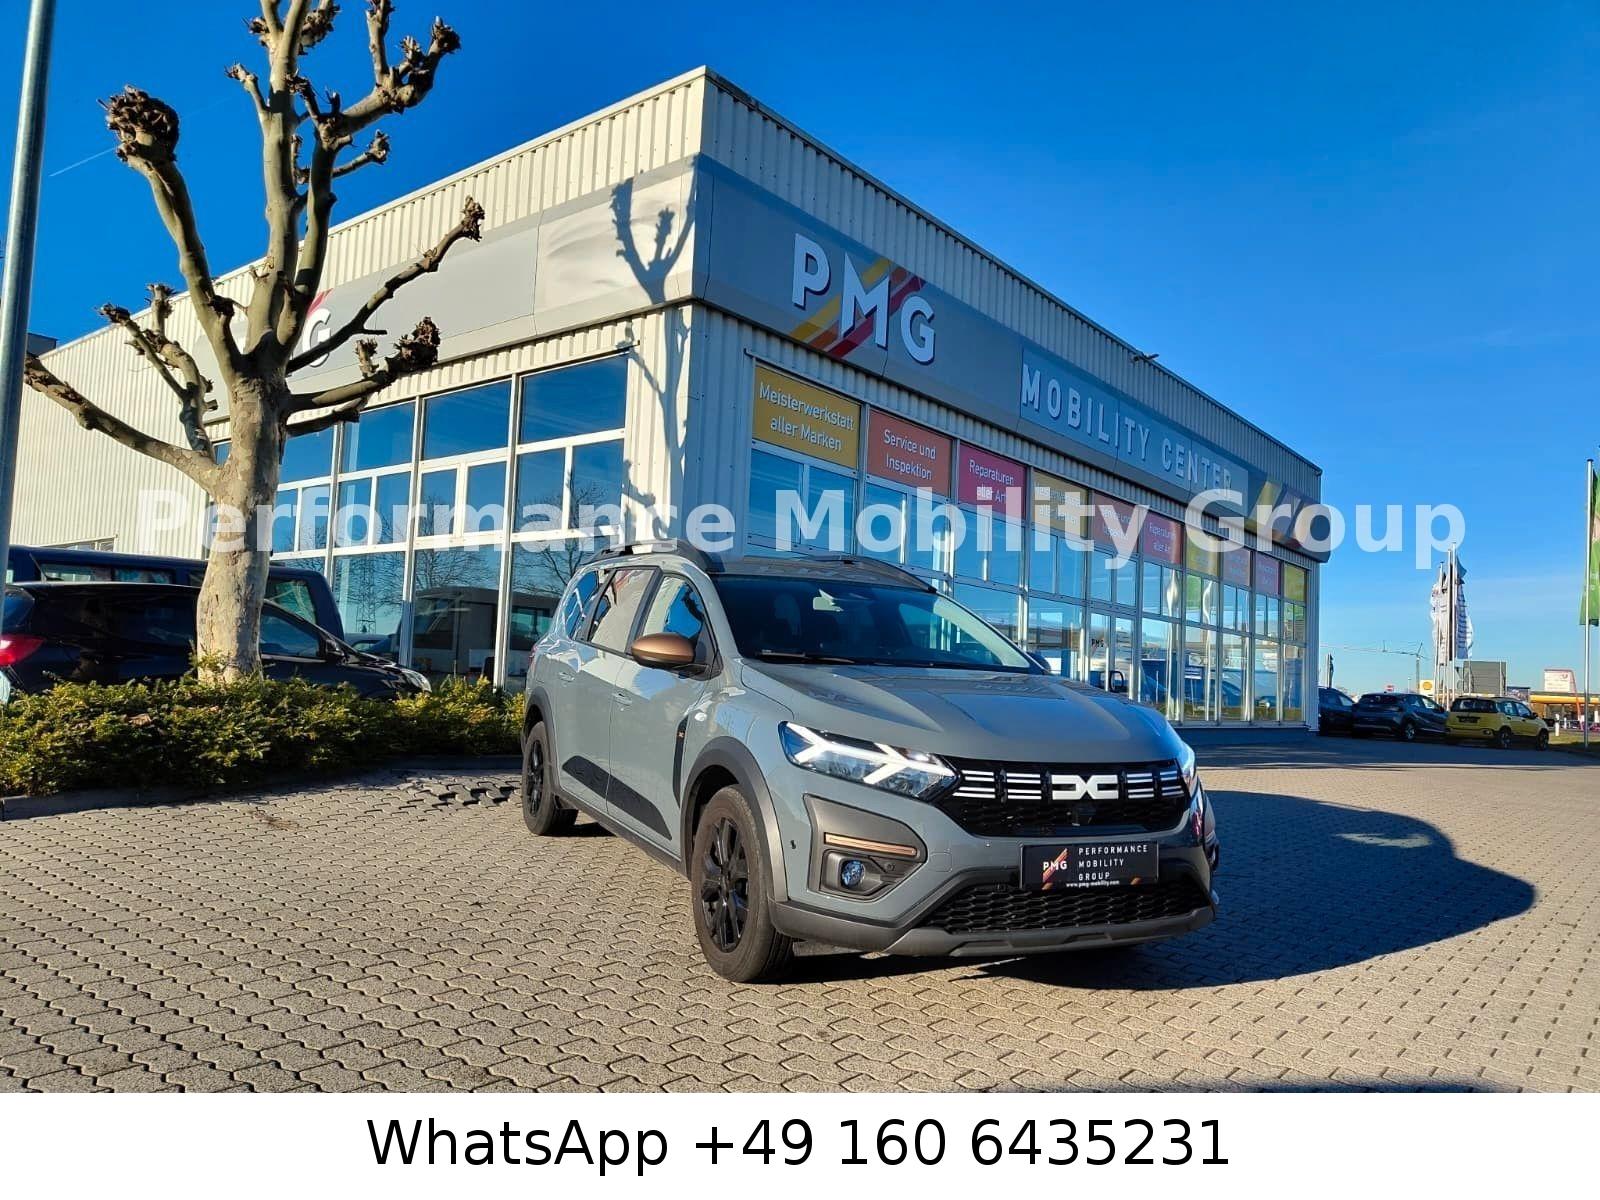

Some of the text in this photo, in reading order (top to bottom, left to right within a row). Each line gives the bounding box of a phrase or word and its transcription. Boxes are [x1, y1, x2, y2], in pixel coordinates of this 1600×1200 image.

[792, 233, 936, 366] PMG
[759, 382, 855, 431] Meisterwerkstatt
[770, 415, 842, 452] aller Marken
[1021, 363, 1233, 497] MOBILITY CENTER
[884, 430, 936, 460] Service und
[886, 457, 932, 480] Inspektion
[969, 459, 1014, 486] Reparaturen
[1078, 844, 1148, 856] PERFORMANCE
[1043, 858, 1124, 871] PMG MOBILITY
[1078, 871, 1110, 881] GROUP
